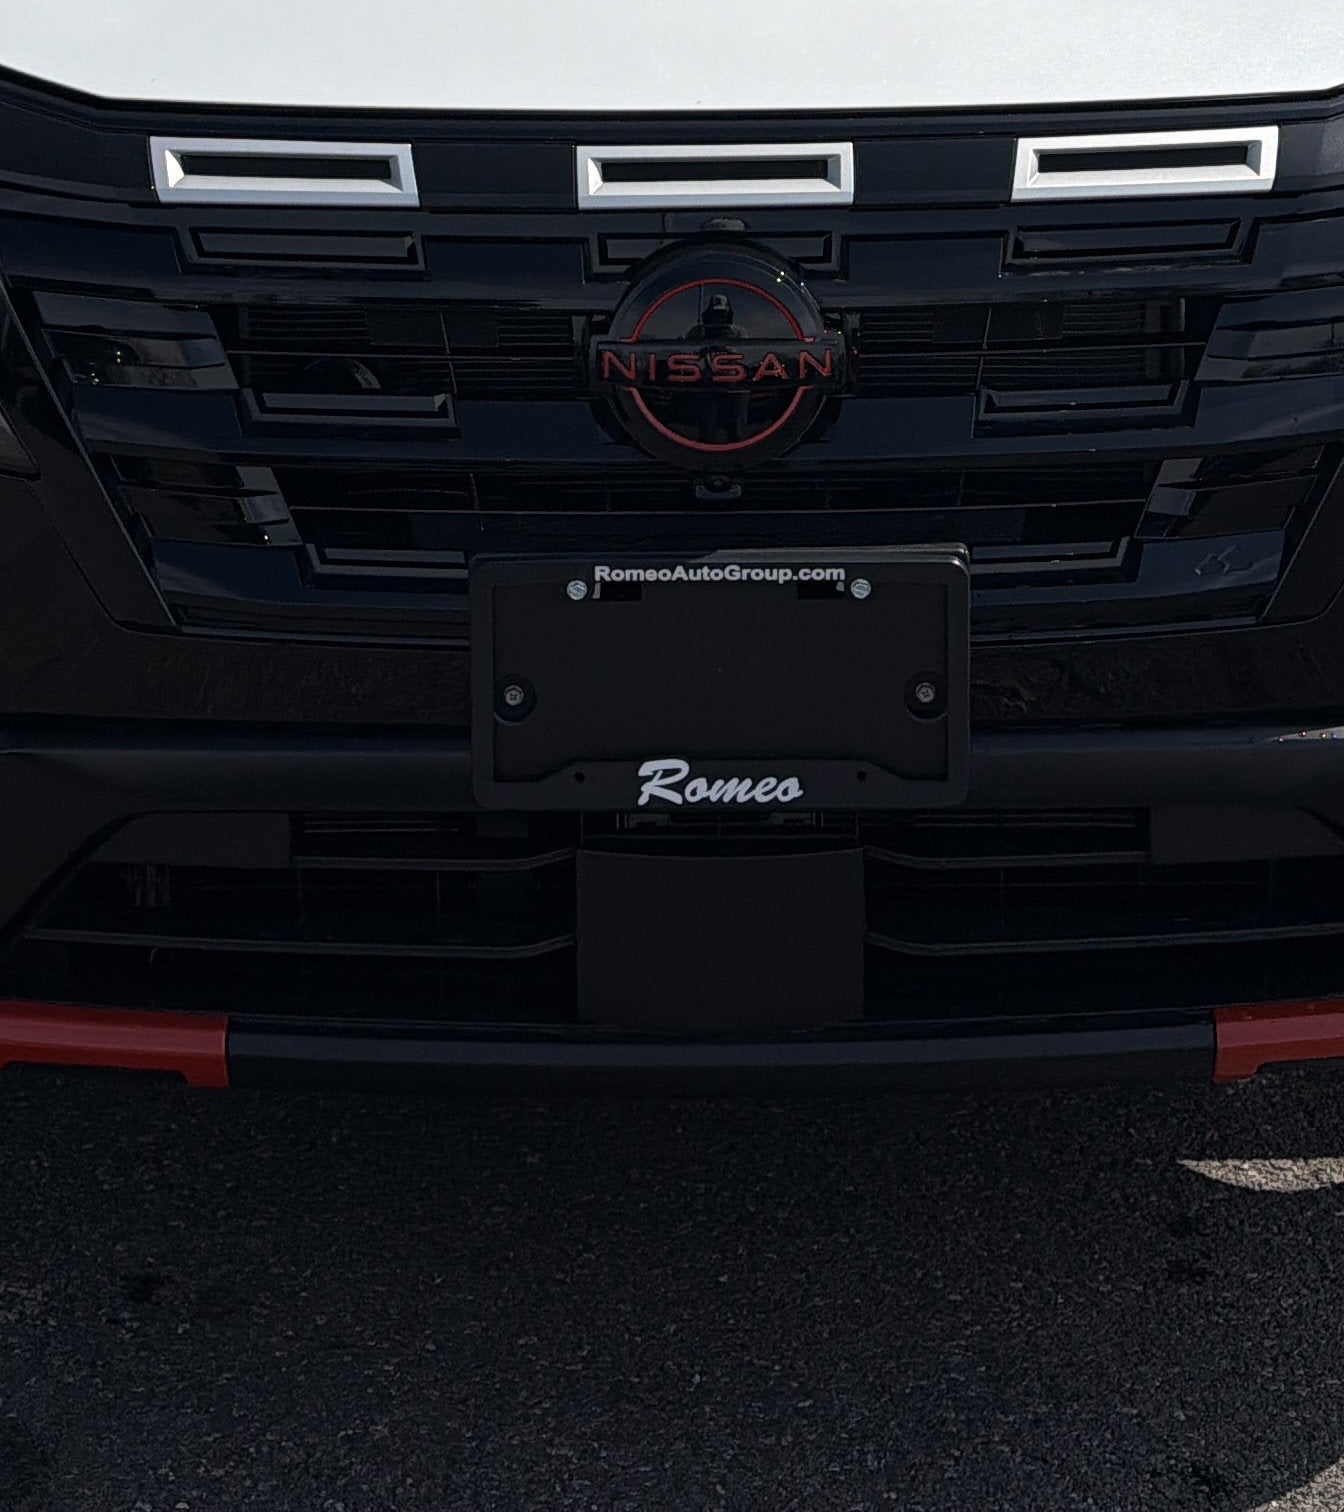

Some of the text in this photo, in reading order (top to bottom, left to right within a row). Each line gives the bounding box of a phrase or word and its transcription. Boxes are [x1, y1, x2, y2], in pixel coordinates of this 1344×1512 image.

[602, 350, 833, 383] NISSAN
[594, 565, 846, 584] RomeoAutoGroup.com
[637, 758, 804, 806] Romeo
